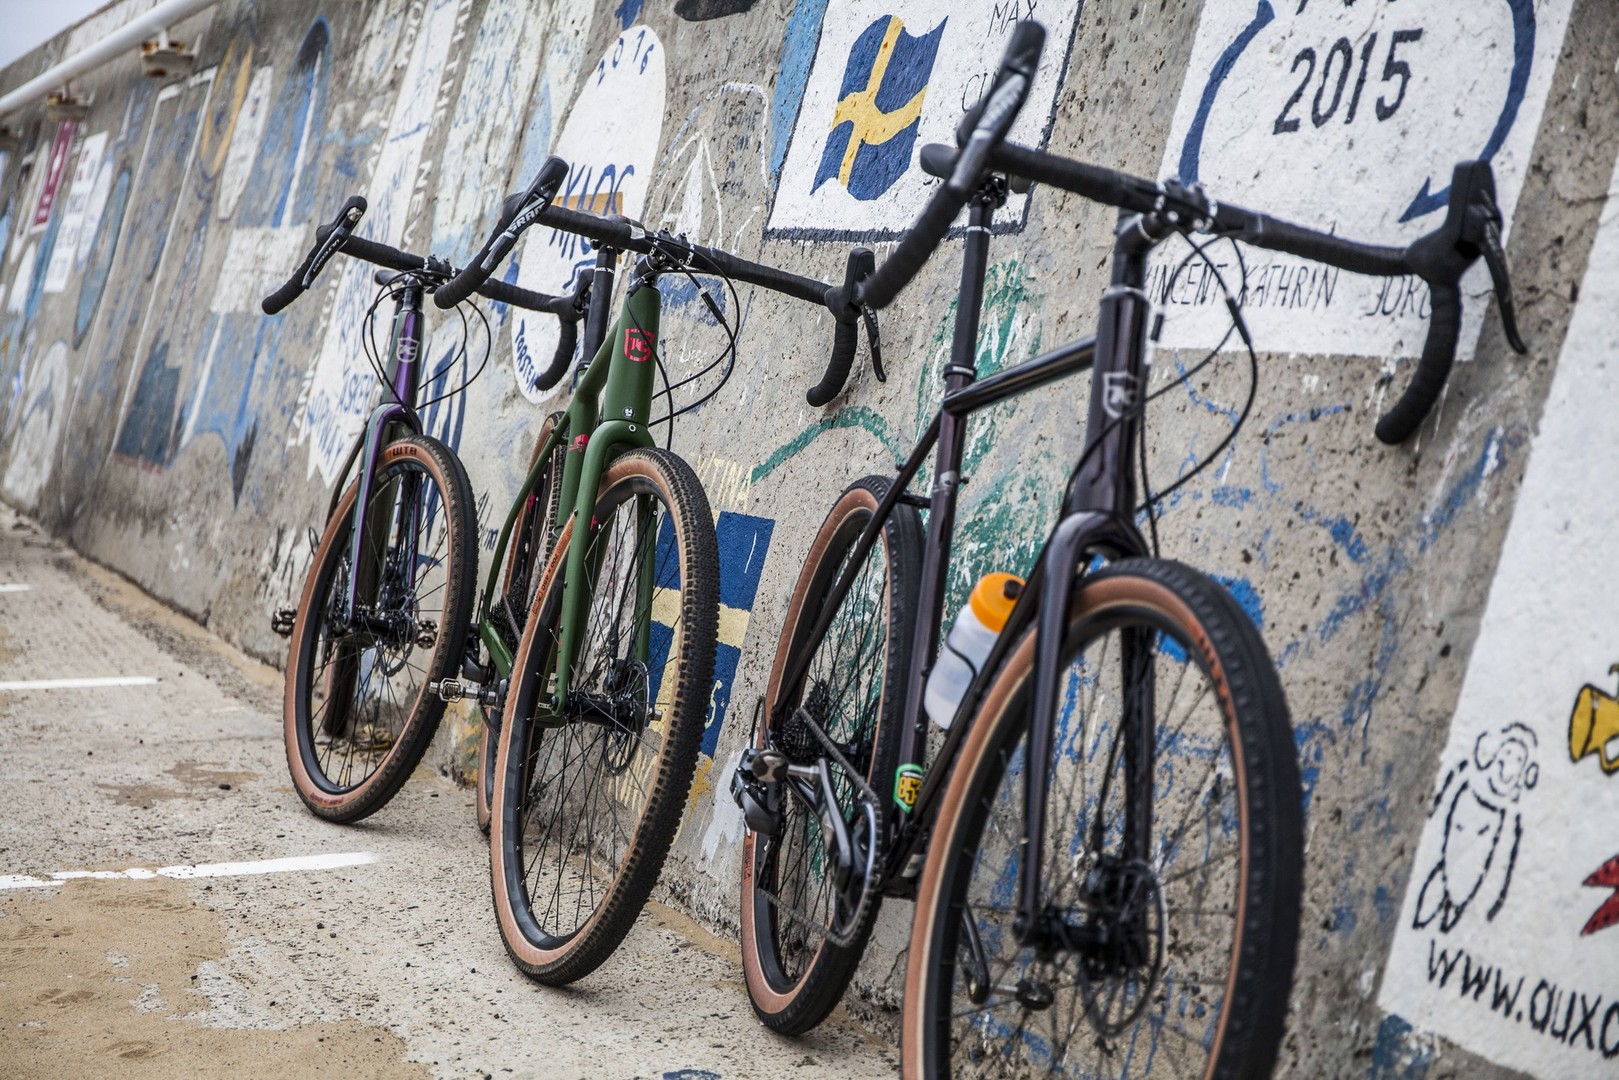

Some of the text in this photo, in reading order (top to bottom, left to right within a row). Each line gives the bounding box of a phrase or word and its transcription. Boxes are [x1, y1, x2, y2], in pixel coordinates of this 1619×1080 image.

[597, 29, 655, 88] 2016
[1272, 28, 1423, 136] 2015
[1235, 264, 1340, 312] KATHRIN
[392, 445, 418, 456] WTB
